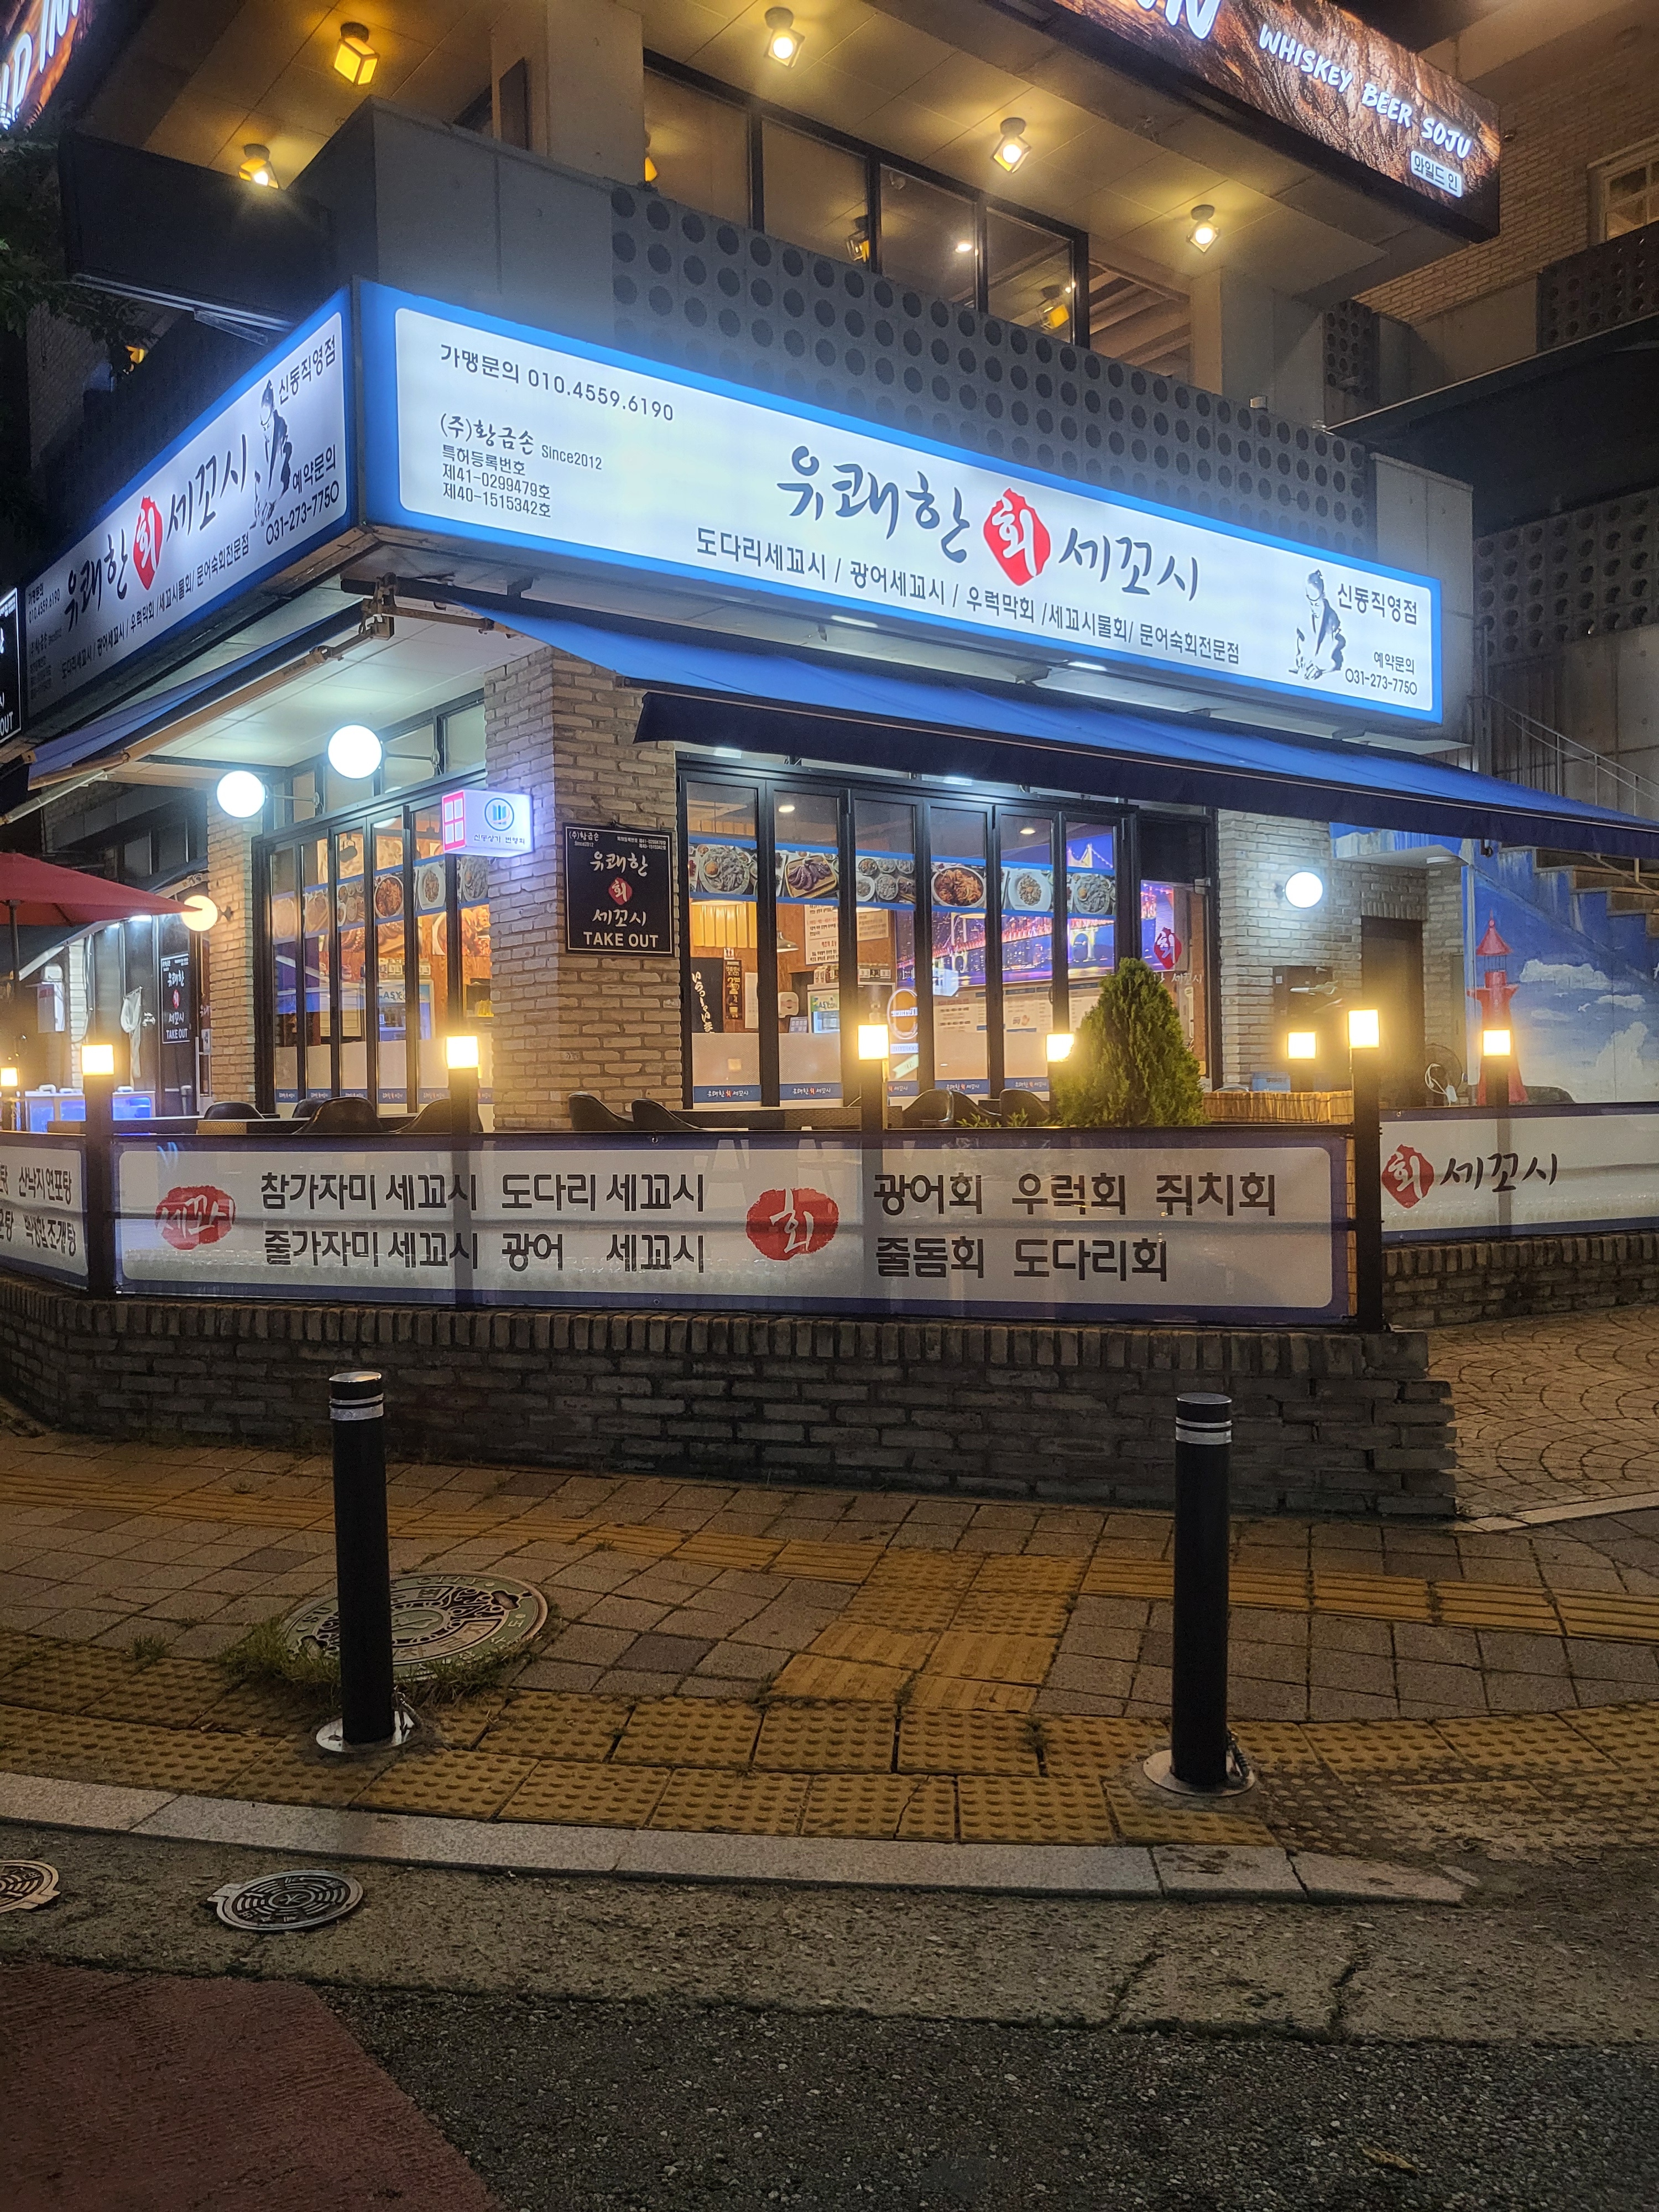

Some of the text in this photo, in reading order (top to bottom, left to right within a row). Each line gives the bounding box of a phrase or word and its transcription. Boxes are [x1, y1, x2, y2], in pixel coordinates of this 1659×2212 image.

[1259, 24, 1472, 159] WHISKEY BEER SOJU
[1413, 155, 1459, 192] 와일드 인
[279, 335, 336, 405] 신동직영점
[441, 345, 673, 421] 가맹문의 010.4559.6190
[441, 413, 602, 470] (주)황금손 Since2012
[442, 445, 525, 476] 특허등록번호
[292, 444, 336, 494] 예약문의
[442, 463, 551, 500] 제41-0299479호
[266, 480, 340, 545] 031-273-7750
[443, 482, 551, 518] 제40-1515342호
[65, 434, 247, 632] 유쾌한 회 세꼬시
[777, 446, 1198, 601] 유쾌한 회 세꼬시
[131, 599, 154, 633] 우럭막회
[197, 531, 249, 588] 문어숙회전문점
[697, 528, 826, 580] 도다리세꼬시
[850, 561, 945, 606] 광어세꼬시
[967, 586, 1034, 623] 우럭막회
[1140, 623, 1239, 665] 문어숙회전문점
[1338, 583, 1417, 625] 신동직영점
[1345, 669, 1417, 695] 031-273-7750
[1374, 651, 1415, 675] 예약문의
[590, 851, 649, 877] 유쾌한
[611, 878, 629, 903] 회
[592, 909, 646, 927] 세꼬시
[583, 931, 659, 948] TAKE OUT
[692, 971, 715, 1033] いらっしゃいま
[166, 1029, 188, 1040] TAKE OUT
[19, 1166, 72, 1205] 산낙지연포탕
[261, 1172, 477, 1211] 참가자미 세꼬시
[502, 1173, 704, 1212] 도다리 세꼬시
[874, 1171, 1275, 1217] 광어회 우럭회 쥐치회
[1385, 1147, 1557, 1204] 회 세꼬시
[762, 1187, 822, 1255] 회
[264, 1230, 478, 1270] 줄가자미 세꼬시
[502, 1232, 704, 1273] 광어 세꼬시
[876, 1236, 1167, 1282] 줄돔회 도다리회
